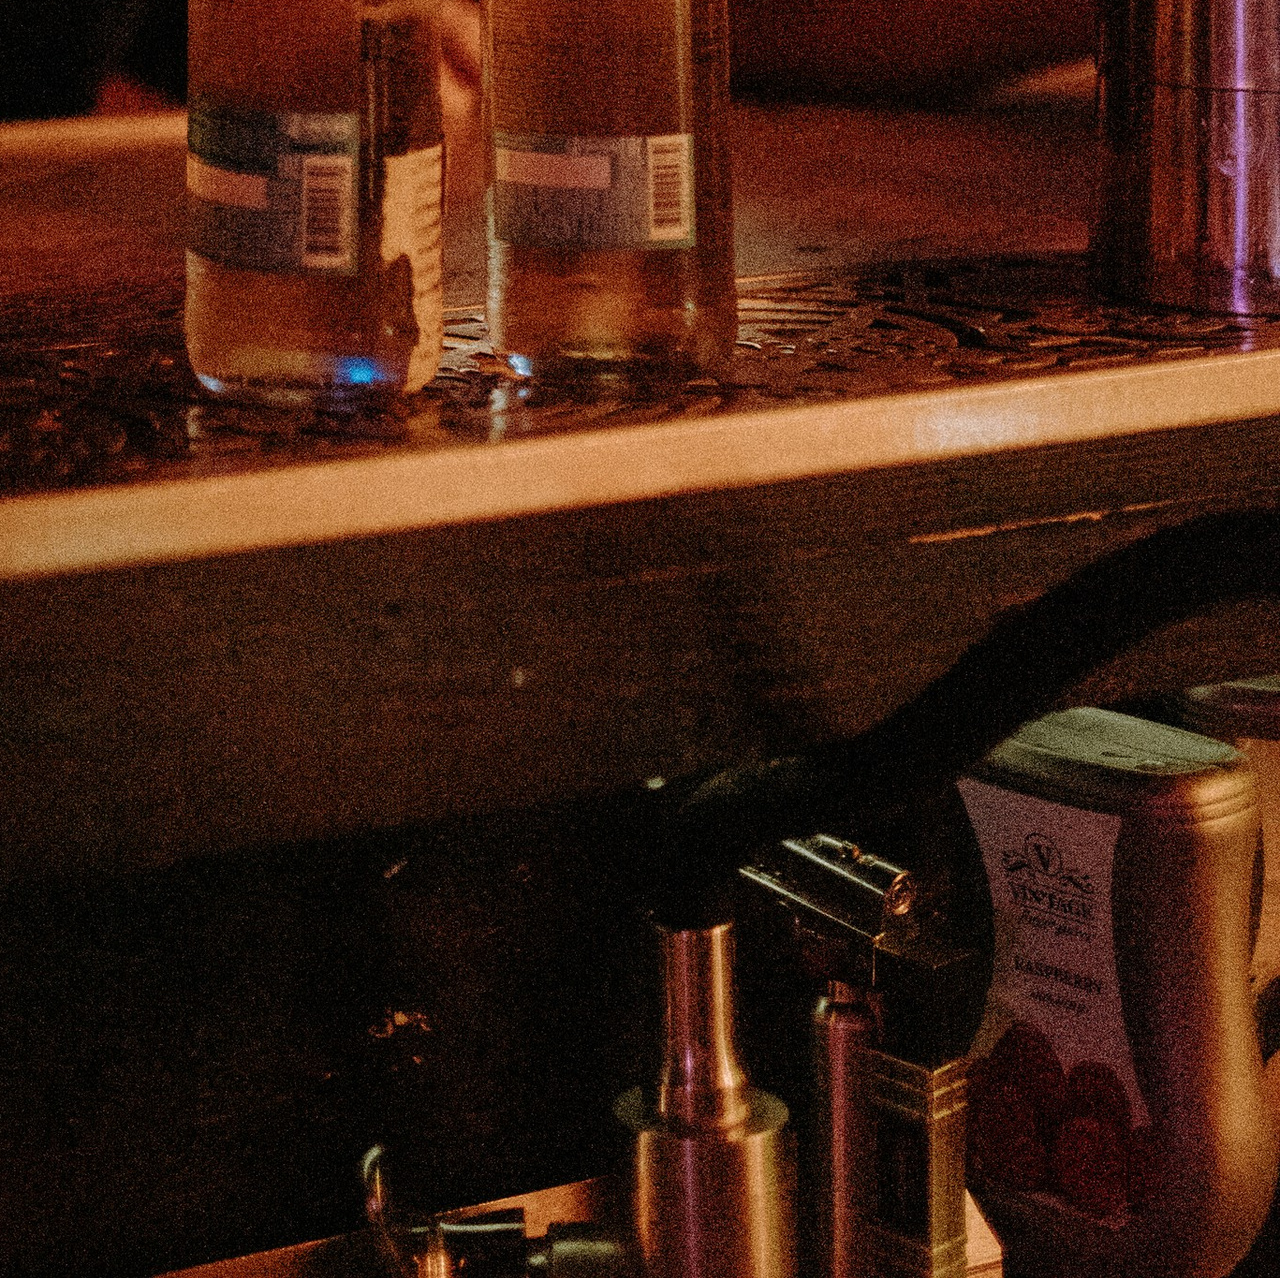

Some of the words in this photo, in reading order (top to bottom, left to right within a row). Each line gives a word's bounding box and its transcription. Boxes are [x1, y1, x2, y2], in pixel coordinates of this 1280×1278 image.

[1033, 843, 1052, 872] V
[1008, 881, 1094, 920] VINTAGE
[1014, 955, 1103, 995] RASPBERRY
